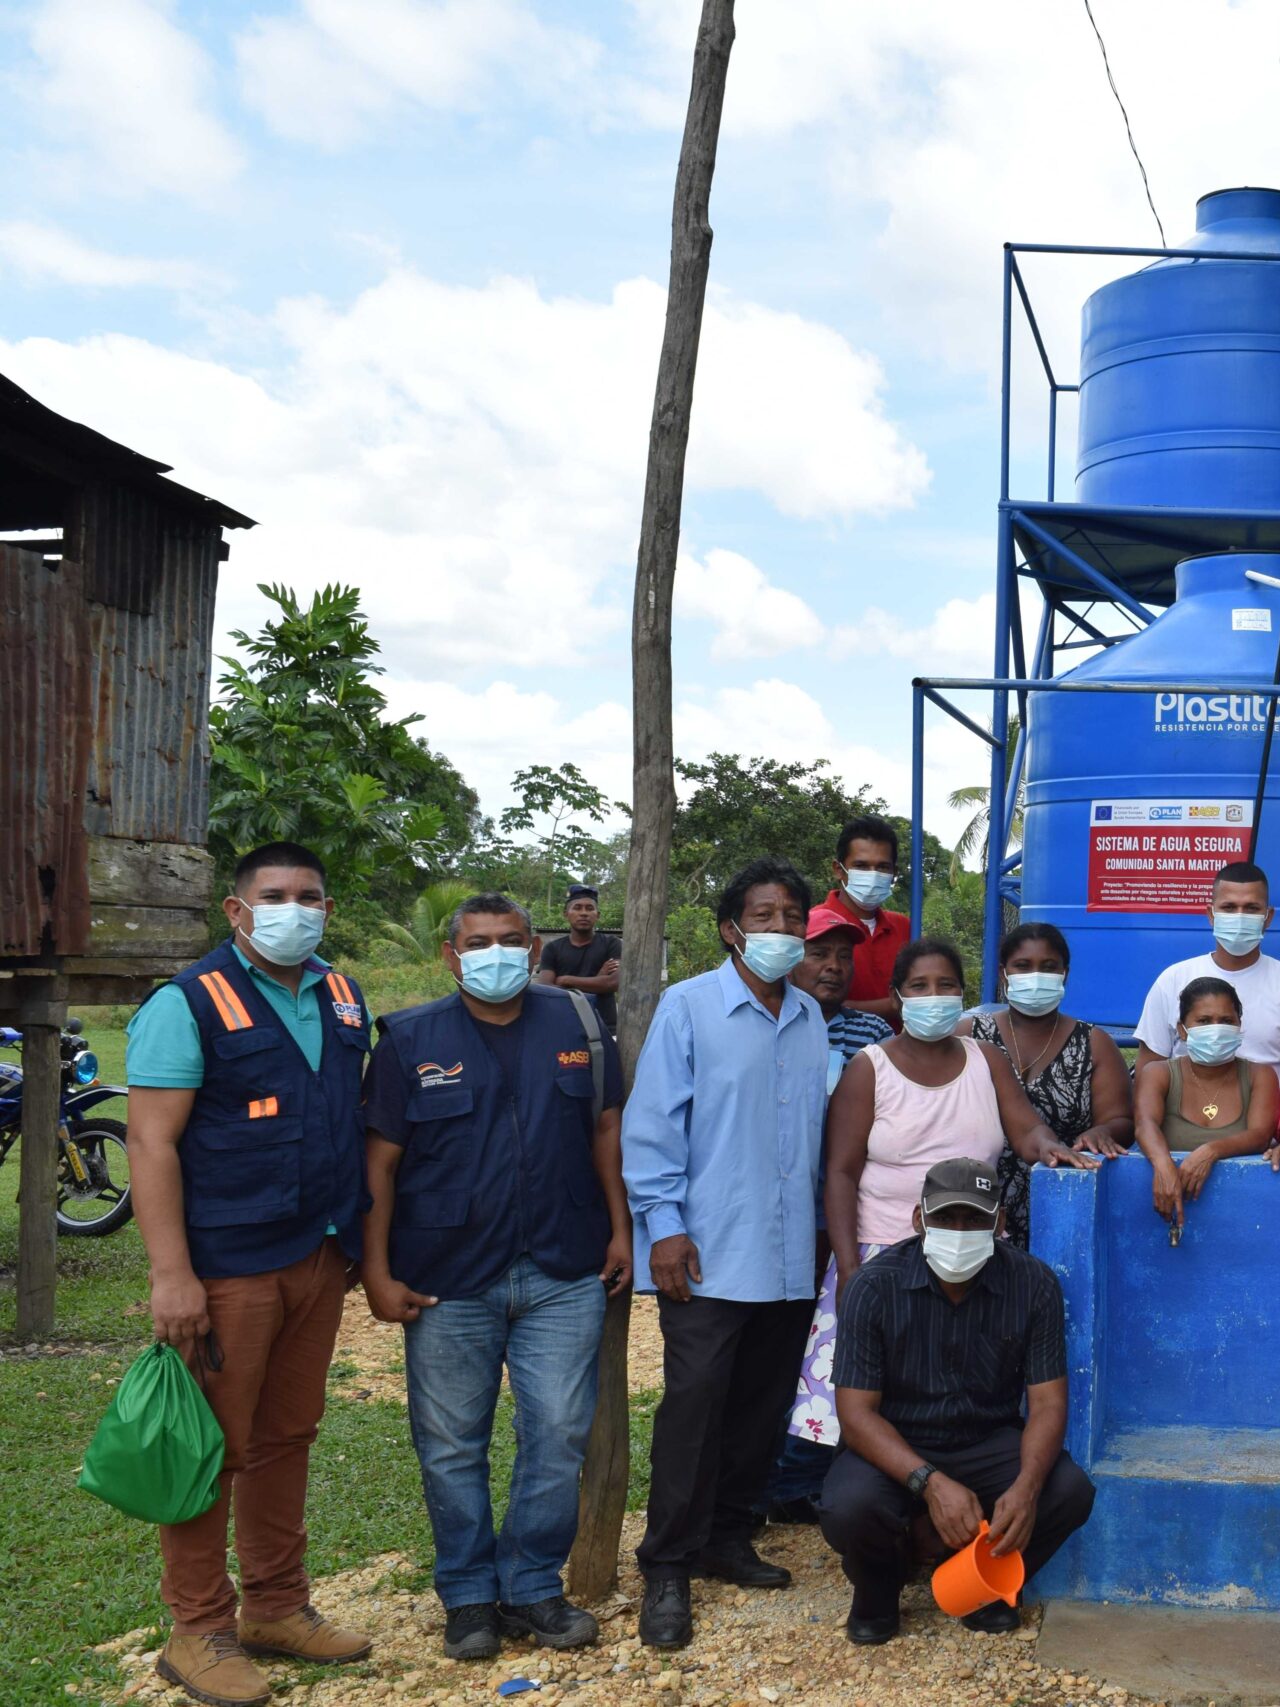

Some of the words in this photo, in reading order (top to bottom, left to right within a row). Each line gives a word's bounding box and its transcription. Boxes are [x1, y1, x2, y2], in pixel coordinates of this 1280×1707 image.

[1155, 723, 1224, 733] RESISTENCIA
[1227, 723, 1248, 732] POR
[1096, 836, 1139, 851] SISTEMA
[1142, 836, 1157, 852] DE
[1160, 836, 1191, 852] AGUA
[1194, 837, 1242, 853] SEGURA
[1105, 858, 1154, 870] COMUNIDAD
[1156, 859, 1185, 871] SANTA
[1188, 859, 1228, 871] MARTHA
[566, 1051, 589, 1063] ASB
